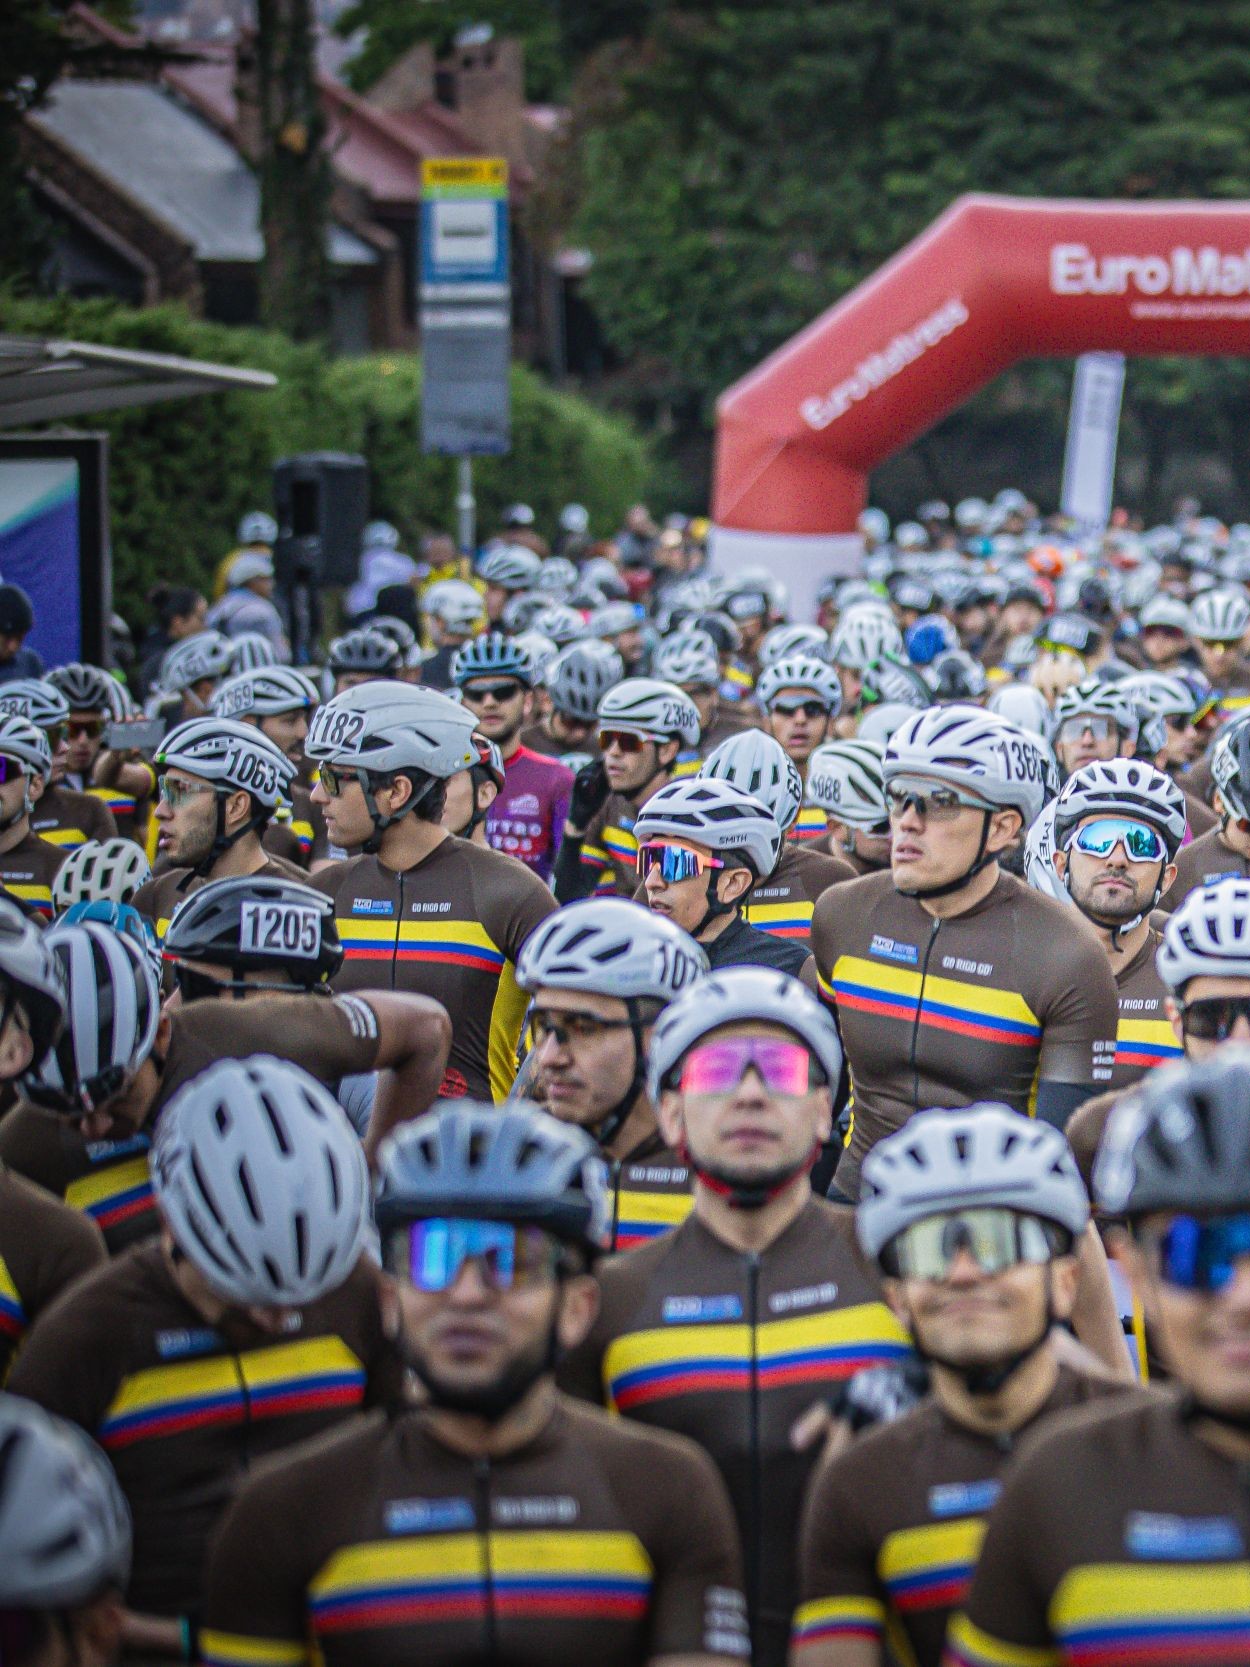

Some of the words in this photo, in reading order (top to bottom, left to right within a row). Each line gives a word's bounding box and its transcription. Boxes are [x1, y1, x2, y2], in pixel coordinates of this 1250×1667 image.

[311, 710, 364, 750] 1182
[227, 750, 278, 796] 1063
[246, 905, 318, 954] 1205
[1124, 999, 1144, 1010] RIGO
